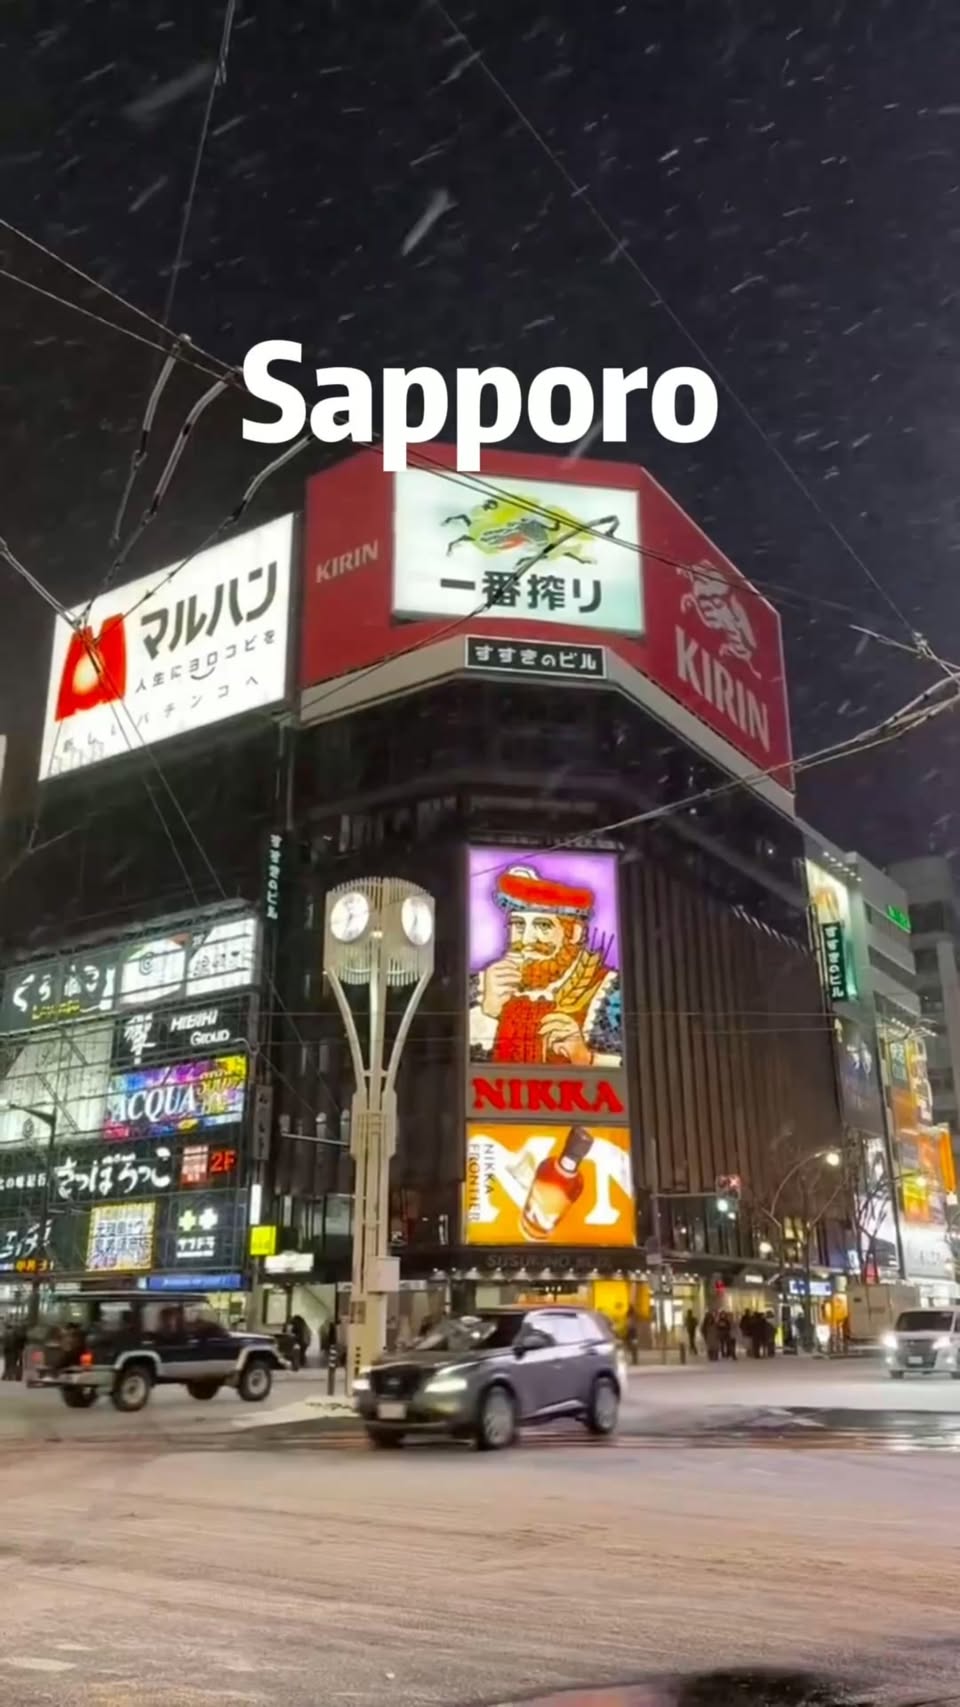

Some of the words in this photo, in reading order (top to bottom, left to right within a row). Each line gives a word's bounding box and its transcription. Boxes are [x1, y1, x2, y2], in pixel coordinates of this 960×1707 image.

[315, 540, 379, 584] KIRIN
[140, 560, 278, 660] マルハン
[440, 570, 602, 614] 一番搾り
[134, 629, 275, 694] 人生にヨロコビを
[474, 645, 597, 671] すすきのビル
[675, 624, 770, 752] KIRIN
[472, 1078, 624, 1114] NIKKA
[210, 1150, 236, 1173] 2F
[468, 1143, 481, 1222] FRONTIER
[484, 1144, 496, 1194] NIKKA
